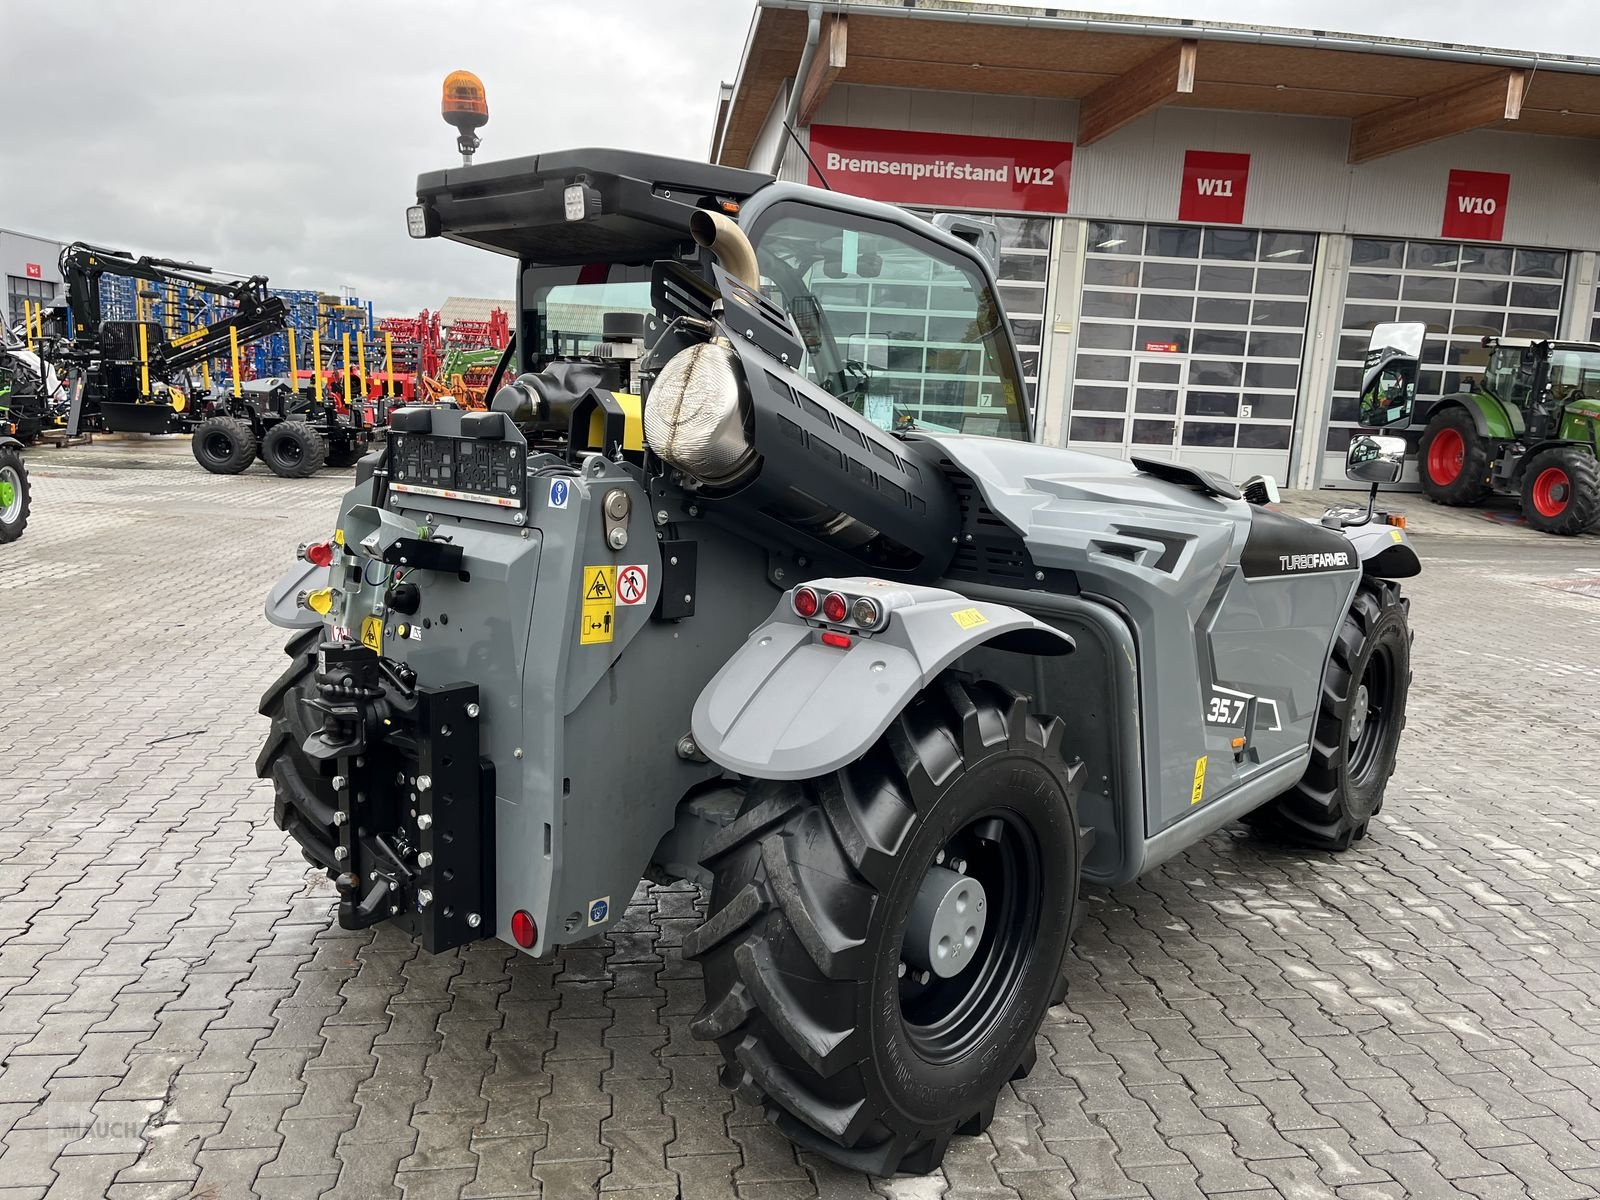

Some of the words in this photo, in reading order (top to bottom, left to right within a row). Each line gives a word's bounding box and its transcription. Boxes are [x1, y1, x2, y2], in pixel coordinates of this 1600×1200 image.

[826, 152, 1008, 184] Bremsenprüfstand
[1014, 166, 1055, 186] W12
[1196, 177, 1233, 198] W11
[1457, 195, 1497, 216] W10
[982, 395, 991, 406] 7
[1241, 405, 1250, 417] 5
[1279, 552, 1350, 571] TURBOFARMER
[1206, 697, 1245, 724] 35.7
